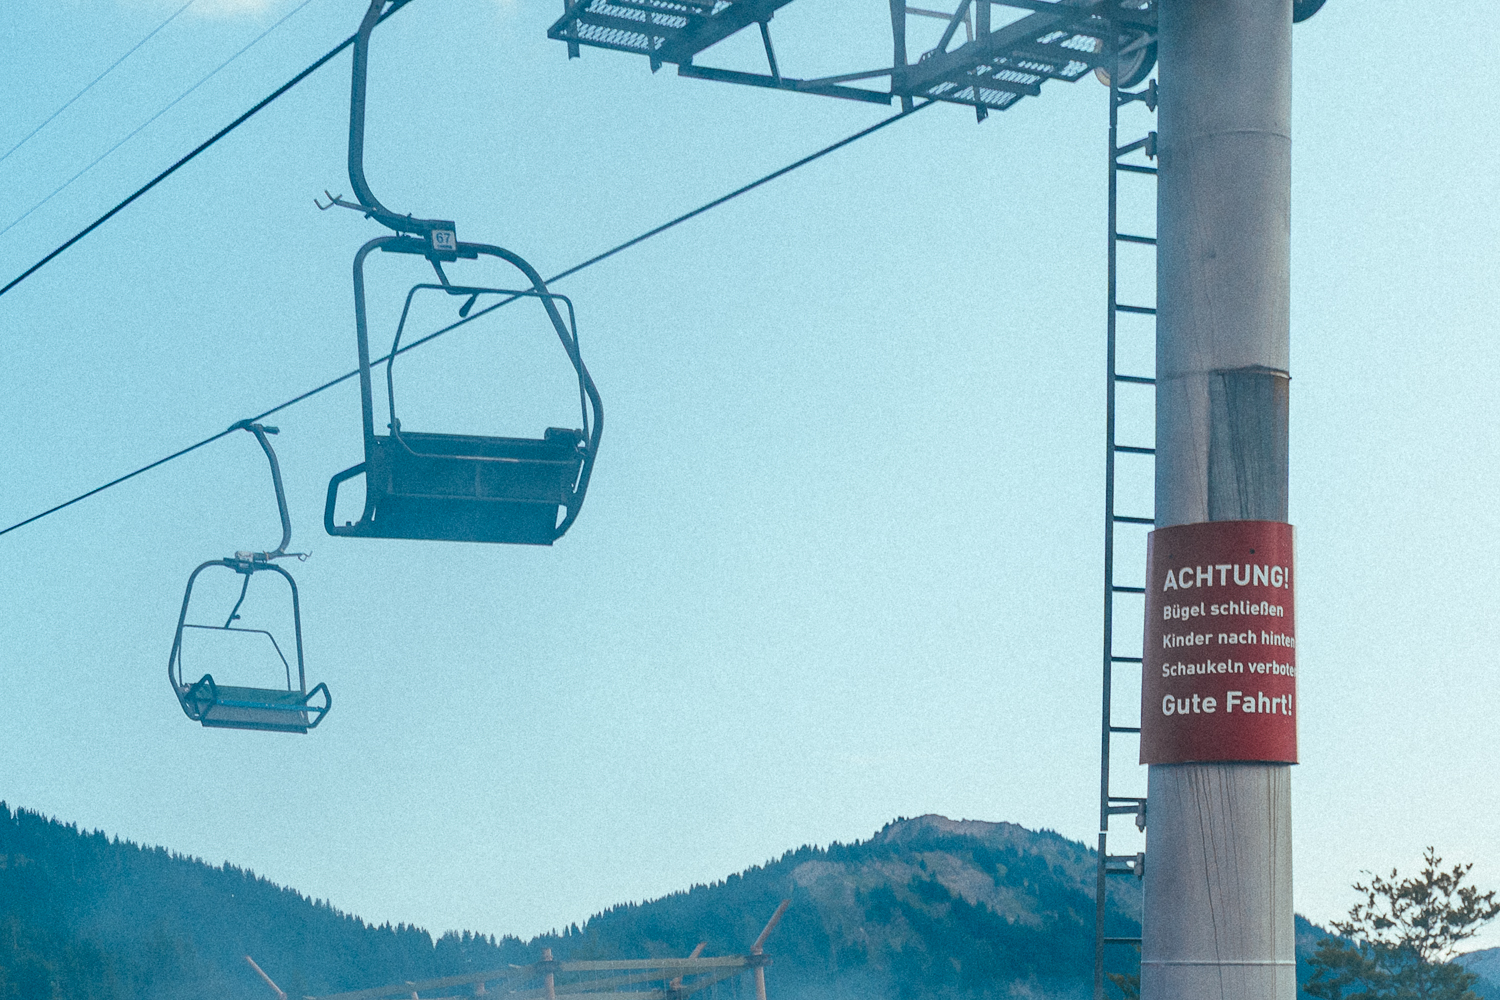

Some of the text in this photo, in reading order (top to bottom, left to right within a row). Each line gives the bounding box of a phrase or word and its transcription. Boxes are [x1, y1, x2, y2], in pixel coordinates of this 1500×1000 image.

[436, 232, 451, 244] 67
[1163, 564, 1289, 591] ACHTUNG!
[1163, 601, 1284, 620] Bügel schließen
[1163, 632, 1213, 649] Kinder
[1218, 630, 1257, 645] nach
[1162, 659, 1297, 677] Schaukeln verbote
[1162, 691, 1293, 716] Gute Fahrt!
